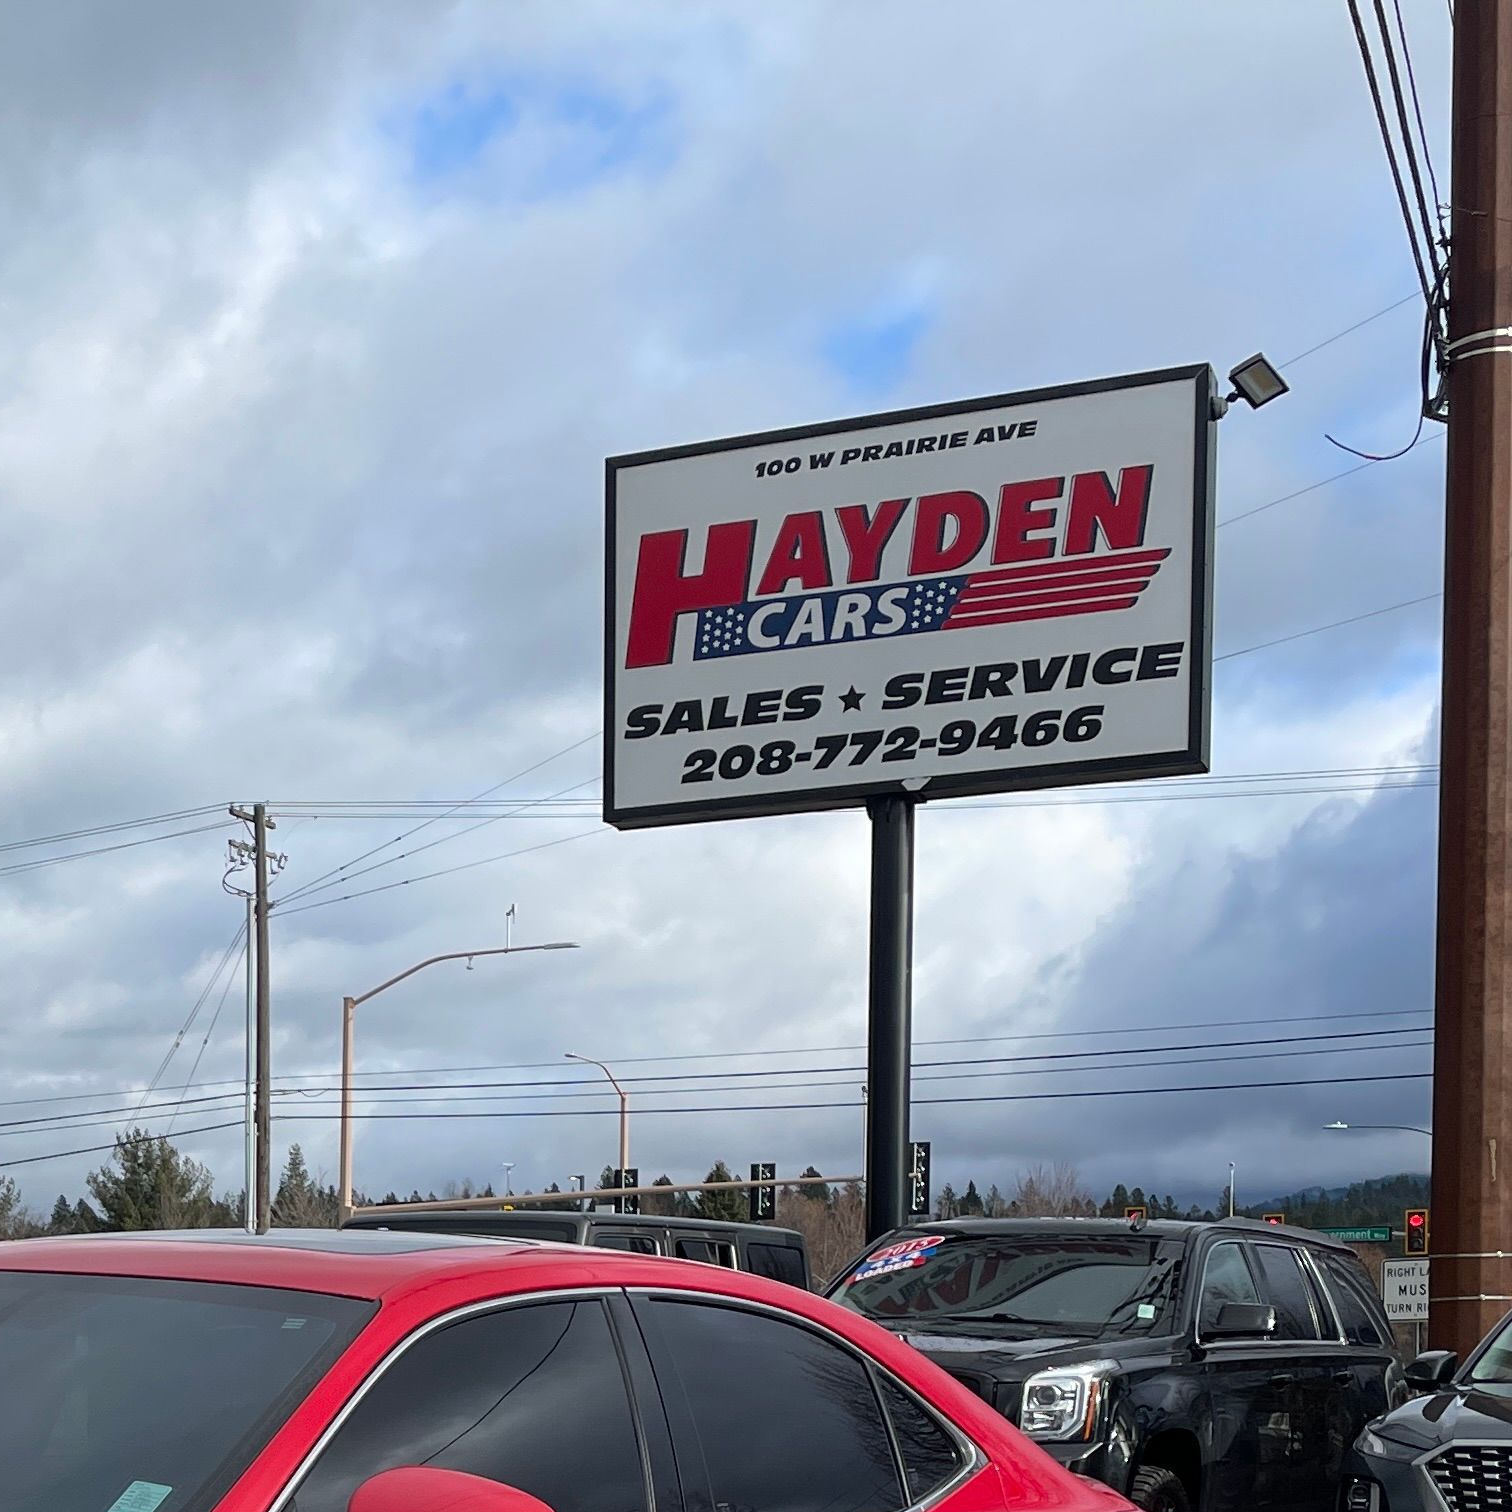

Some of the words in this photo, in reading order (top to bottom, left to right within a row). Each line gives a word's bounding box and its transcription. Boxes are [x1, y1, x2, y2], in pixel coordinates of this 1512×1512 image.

[755, 457, 801, 479] 100
[809, 450, 836, 471] W
[840, 431, 968, 467] PRAIRIE
[974, 420, 1038, 446] AVE
[625, 464, 1155, 670] HAYDEN
[746, 585, 913, 650] CARS
[624, 684, 824, 740] SALES
[881, 641, 1185, 711] SERVICE
[681, 705, 1105, 785] 208-772-9466
[855, 1259, 915, 1281] LOADED
[1387, 1267, 1416, 1278] RIGHT
[1398, 1284, 1427, 1297] MUS
[1386, 1303, 1412, 1314] TURN
